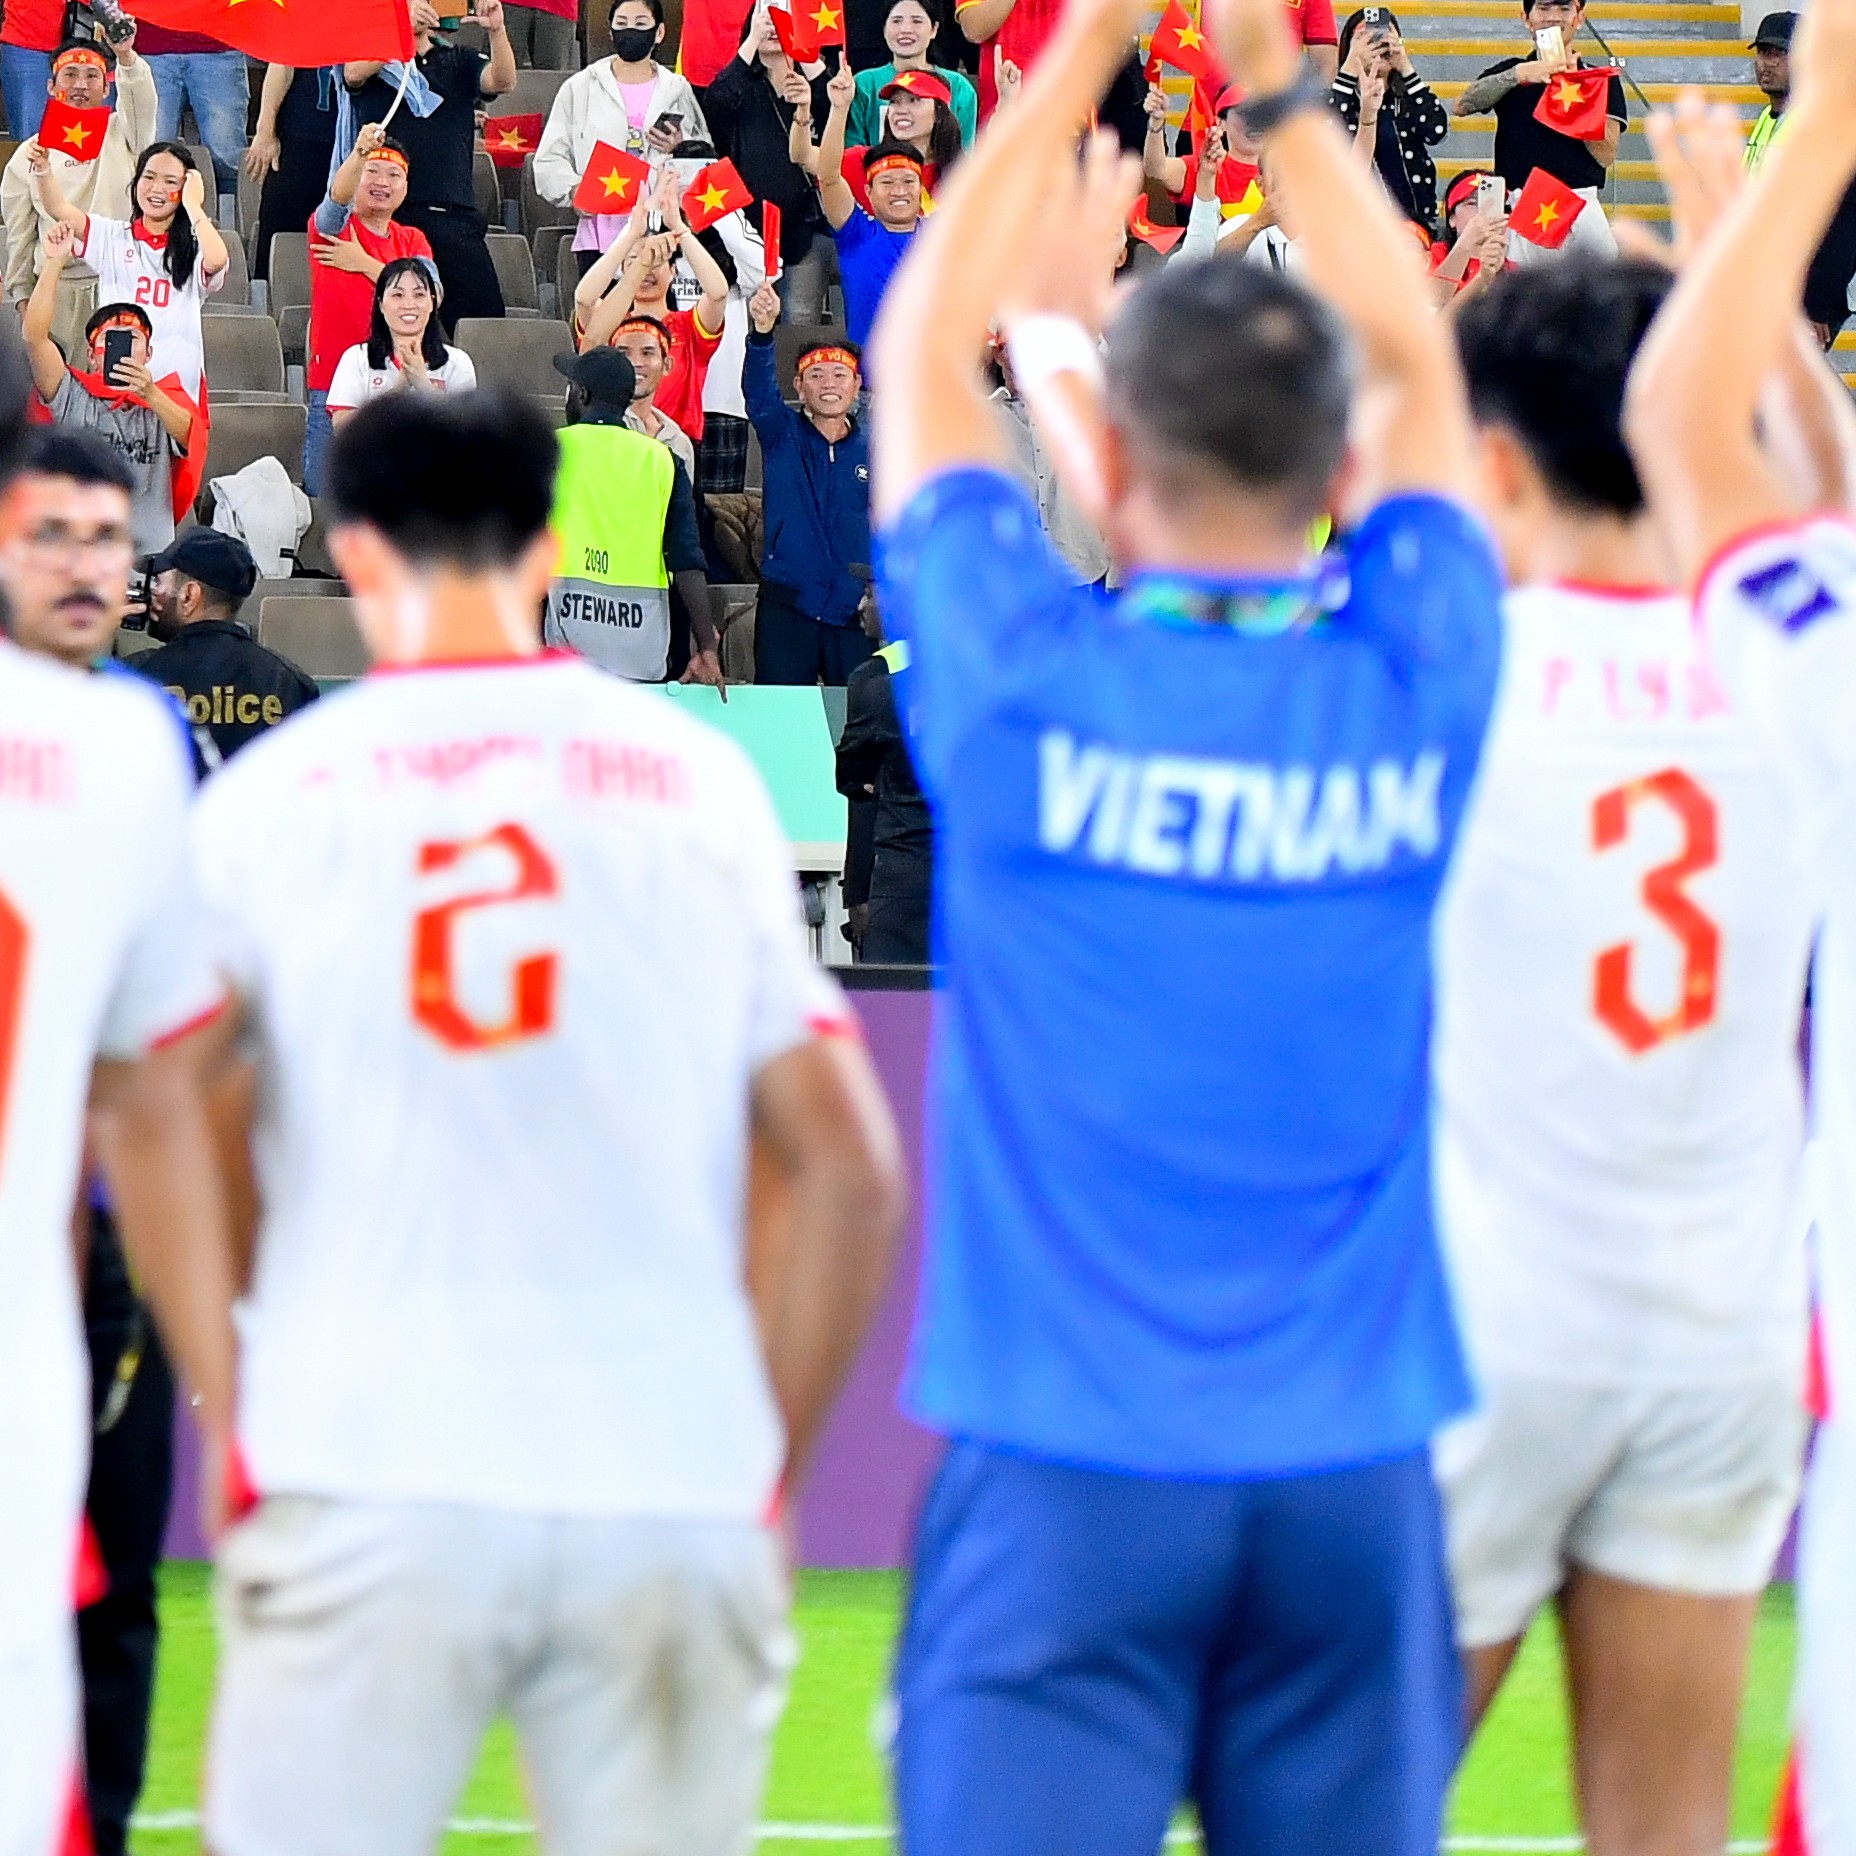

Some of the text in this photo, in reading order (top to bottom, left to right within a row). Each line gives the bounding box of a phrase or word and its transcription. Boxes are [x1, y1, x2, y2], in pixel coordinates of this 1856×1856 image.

[134, 275, 171, 308] 20
[559, 590, 643, 630] STEWARD
[1036, 727, 1447, 884] VIETNAM
[412, 821, 560, 1050] 2
[1591, 766, 1719, 1056] 3
